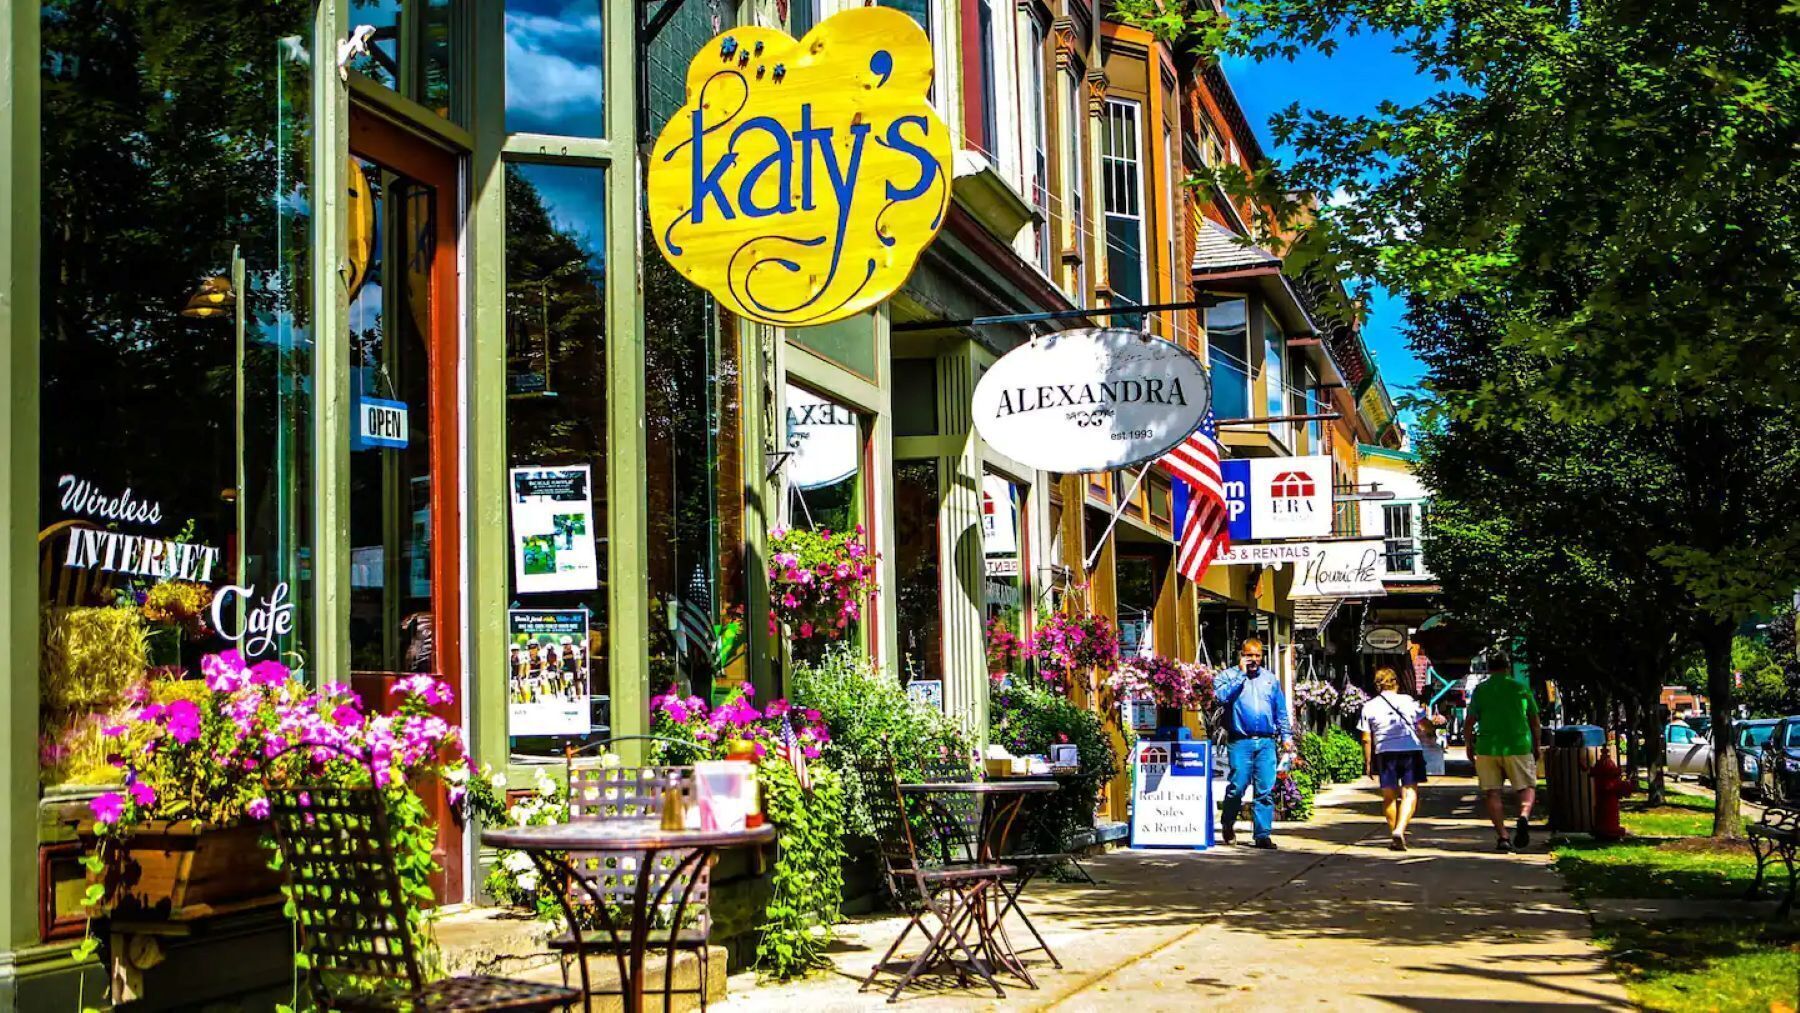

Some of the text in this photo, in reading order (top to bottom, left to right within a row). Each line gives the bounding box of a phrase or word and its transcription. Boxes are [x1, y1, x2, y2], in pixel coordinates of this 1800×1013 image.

[664, 50, 947, 324] katy's
[995, 376, 1188, 418] ALEXANDRA
[368, 406, 401, 438] OPEN
[58, 474, 163, 524] Wireless
[1271, 499, 1314, 513] ERA
[63, 525, 220, 583] INTERNET
[1240, 545, 1249, 560] &
[1253, 545, 1311, 559] RENTALS
[1139, 790, 1203, 801] Real Estate
[1155, 805, 1184, 817] Sales
[1155, 822, 1199, 833] Rentals
